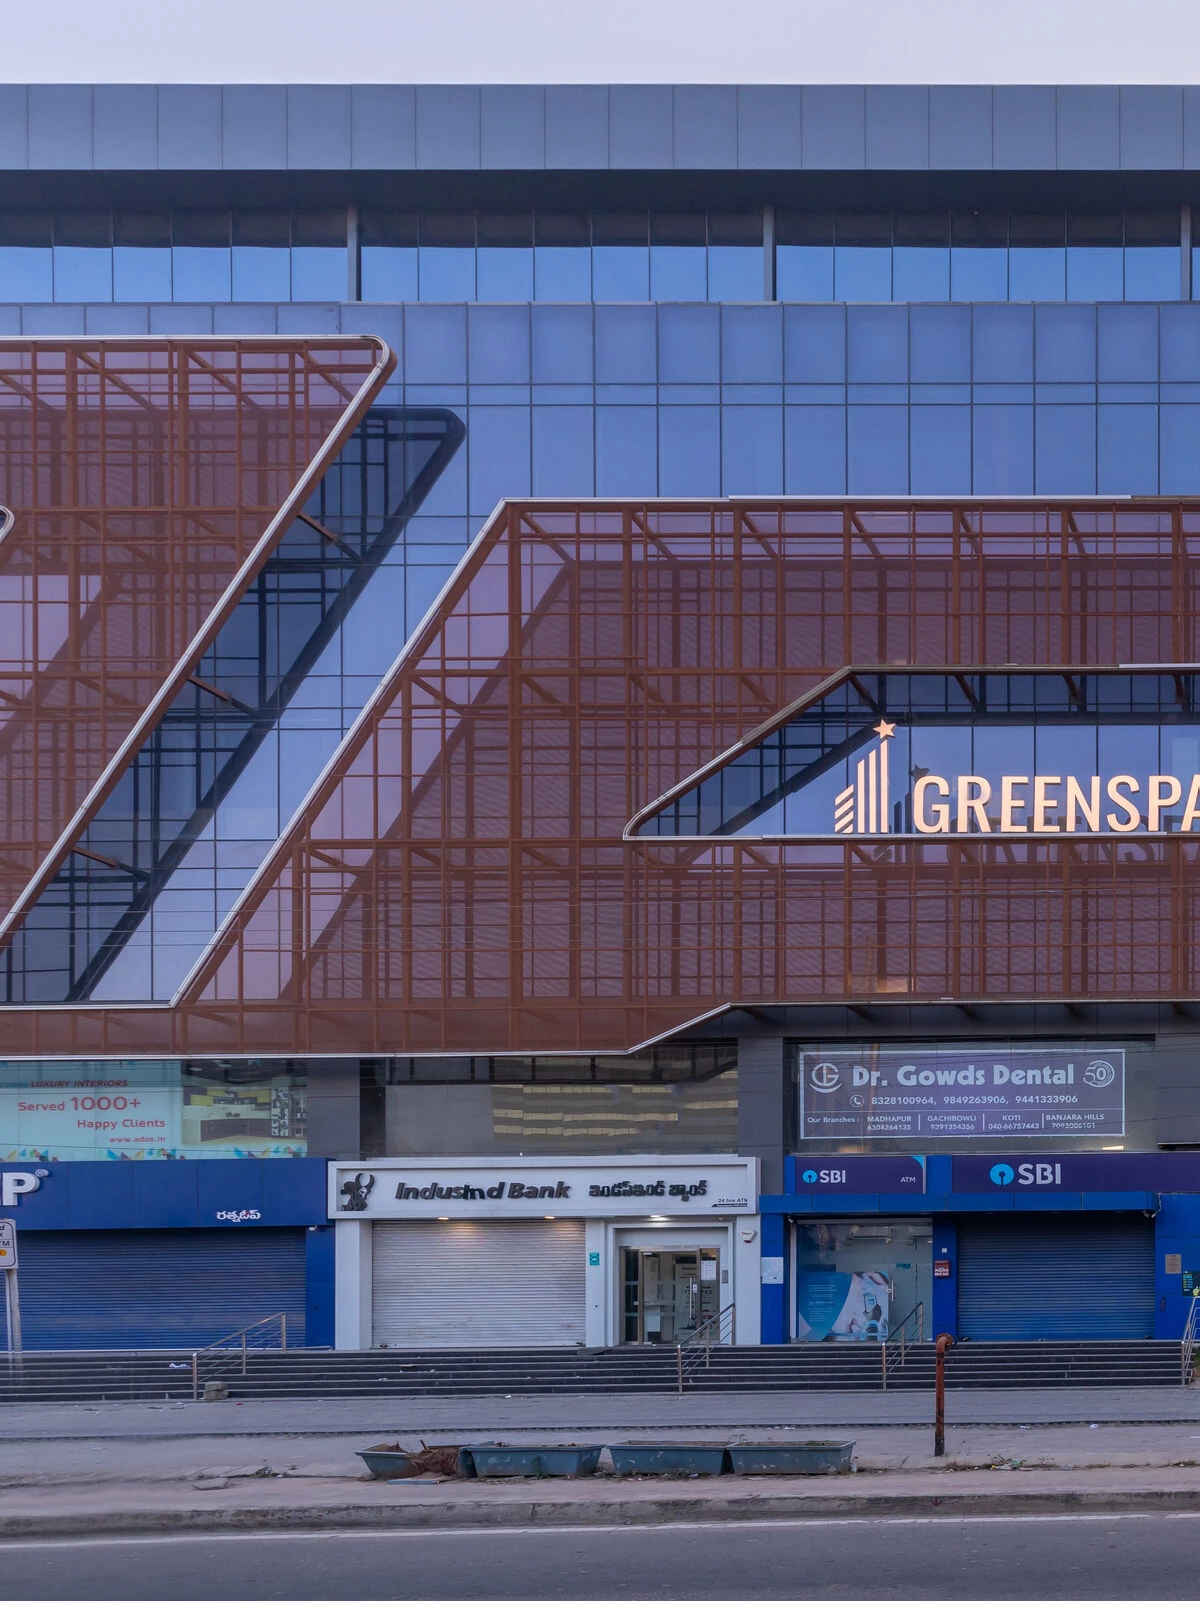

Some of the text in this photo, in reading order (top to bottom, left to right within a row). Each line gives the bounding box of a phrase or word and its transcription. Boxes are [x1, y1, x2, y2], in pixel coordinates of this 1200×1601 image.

[852, 1063, 1075, 1087] Dr. Gowds Dental
[30, 1080, 70, 1088] LUXURY
[73, 1079, 128, 1087] INTERIORS
[18, 1096, 141, 1112] Served 1000+
[1015, 1095, 1078, 1104] 9441333906
[1045, 1113, 1105, 1121] BANJARA HILLS
[77, 1118, 166, 1131] Happy Clients
[109, 1135, 166, 1143] www.ados.in
[819, 1169, 847, 1184] SBI
[1018, 1163, 1062, 1186] SBI
[507, 1181, 571, 1199] Bank
